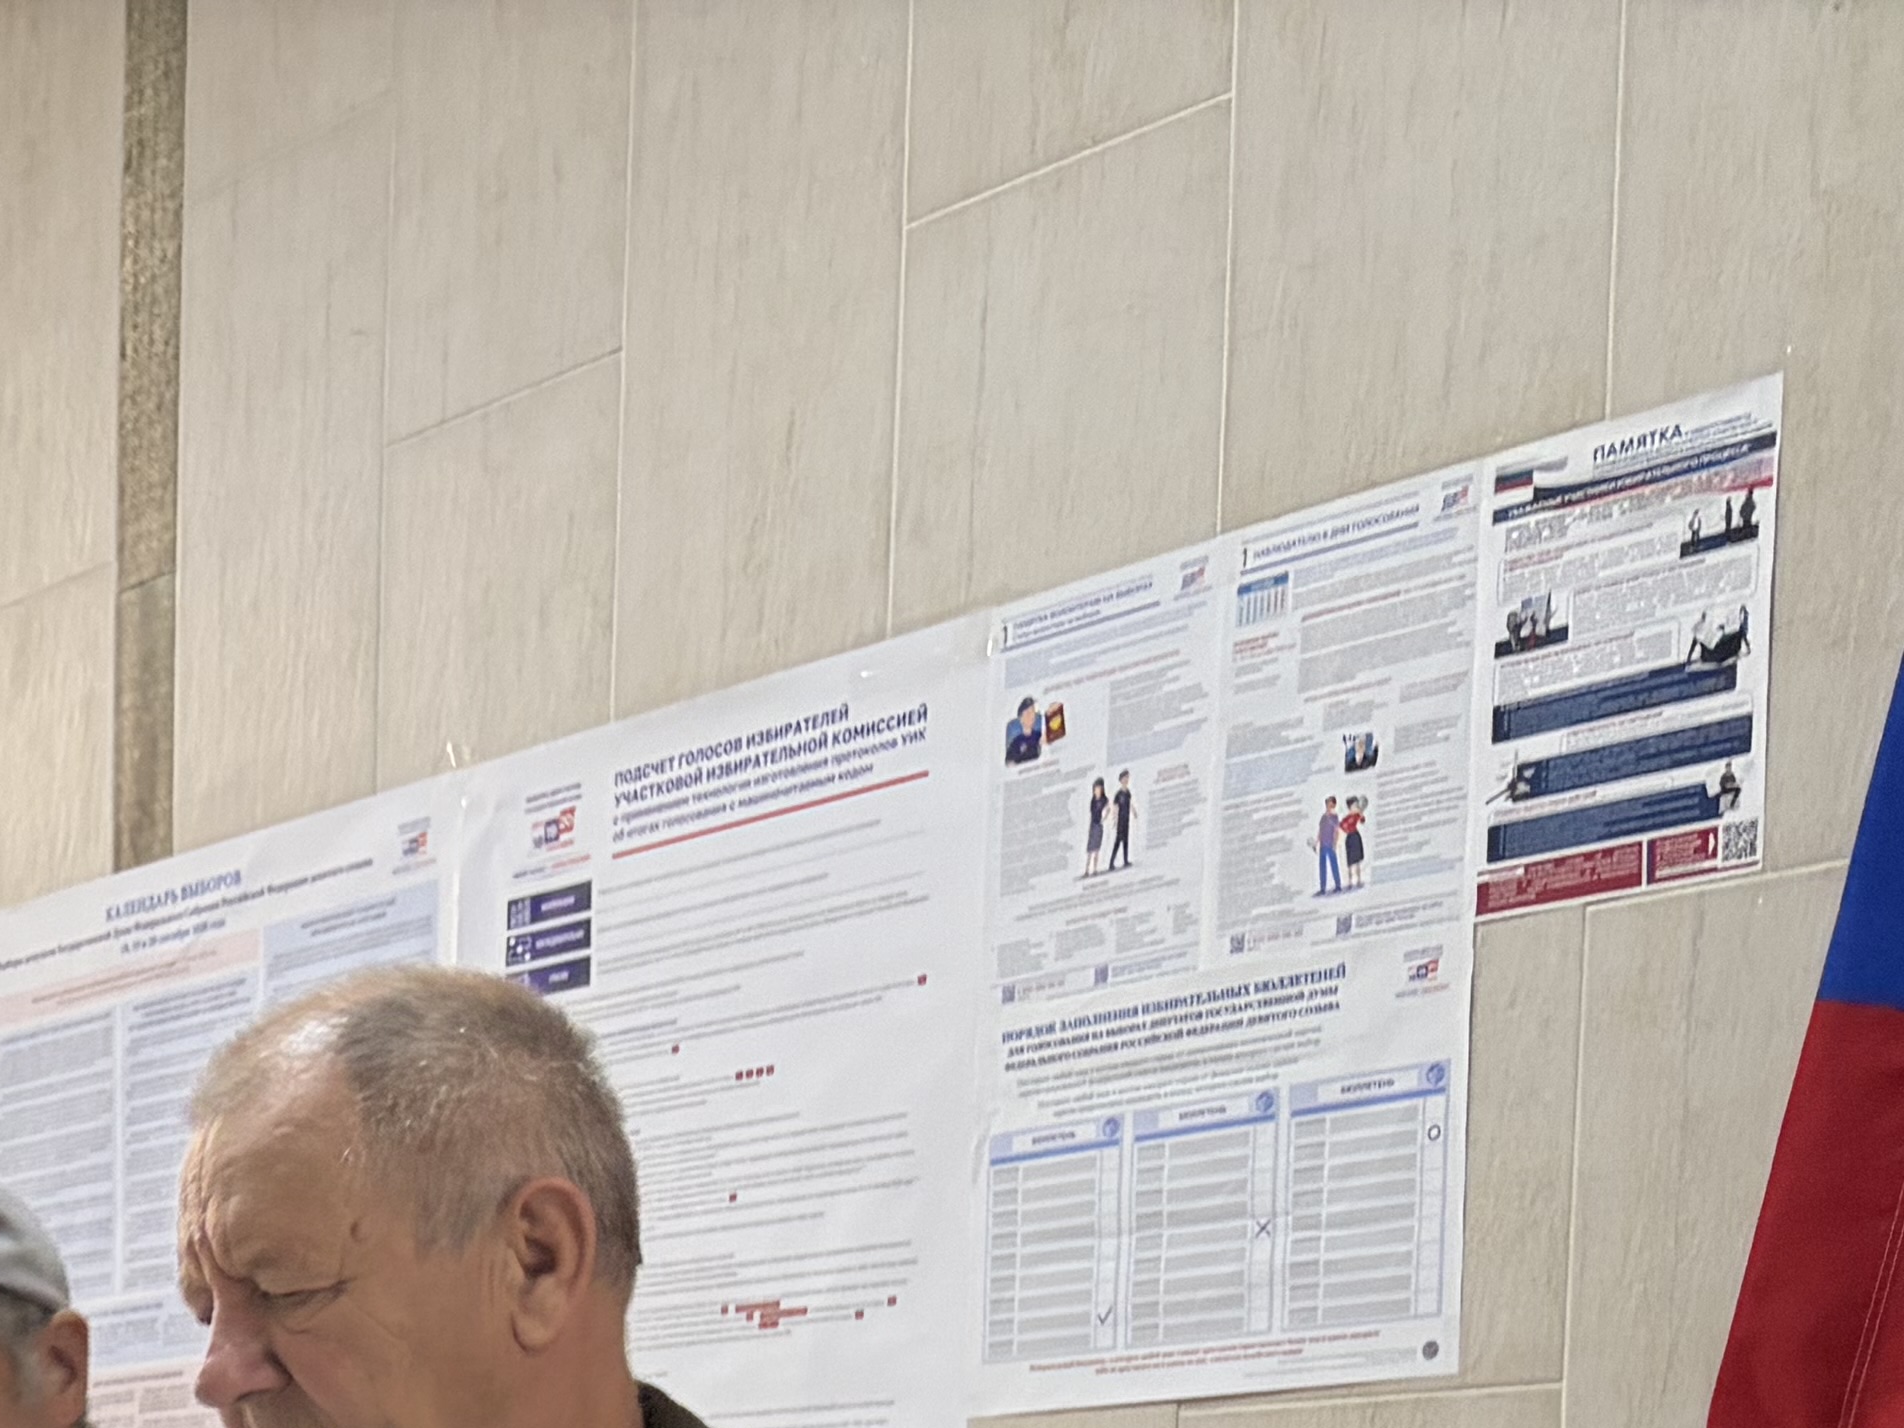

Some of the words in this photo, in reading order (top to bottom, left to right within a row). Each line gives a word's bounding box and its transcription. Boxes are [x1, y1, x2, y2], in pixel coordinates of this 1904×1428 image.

[1594, 424, 1682, 462] ПАМЯТКА
[614, 756, 675, 788] ПОДСЧЕТ
[678, 737, 743, 769] ГОЛОСОВ
[746, 702, 849, 750] ИЗБИРАТЕЛЕЙ
[614, 767, 703, 808] УЧАСТКОВОЙ
[706, 731, 828, 782] ИЗБИРАТЕЛЬНОЙ
[831, 702, 928, 748] КОМИССИЕЙ
[901, 727, 927, 747] УИК
[106, 889, 178, 922] КАЛЕНДАРЬ
[181, 870, 242, 901] ВЫБОРОВ
[1002, 1021, 1056, 1044] ПОРЯДОК
[1060, 1005, 1140, 1031] ЗАПОЛНЕНИЯ
[1142, 983, 1251, 1016] ИЗБИРАТЕЛЬНЫХ
[1254, 961, 1346, 995] БЮЛЛЕТЕНЕЙ
